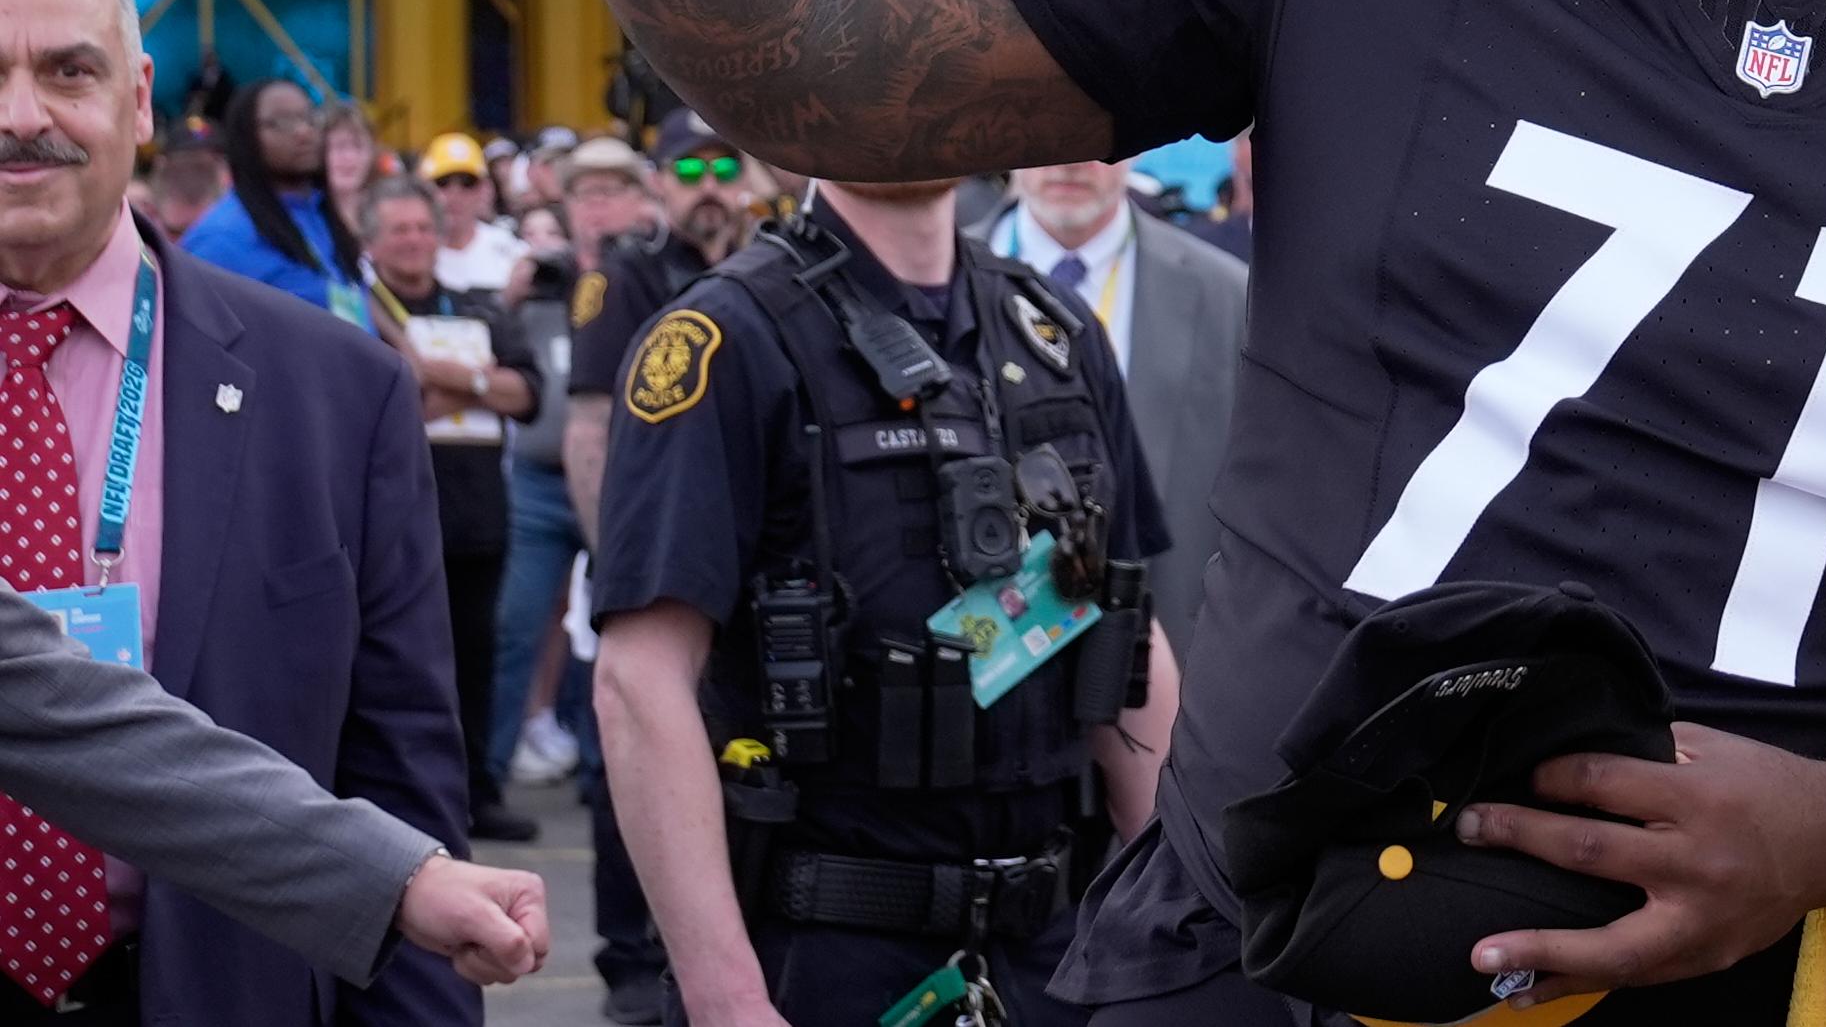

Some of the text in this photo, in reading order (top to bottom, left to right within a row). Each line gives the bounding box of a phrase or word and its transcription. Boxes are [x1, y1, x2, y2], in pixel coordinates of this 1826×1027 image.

[1748, 49, 1792, 82] NFL
[110, 410, 139, 479] DRAFT
[103, 475, 128, 521] NFL
[1433, 665, 1529, 698] Steelers
